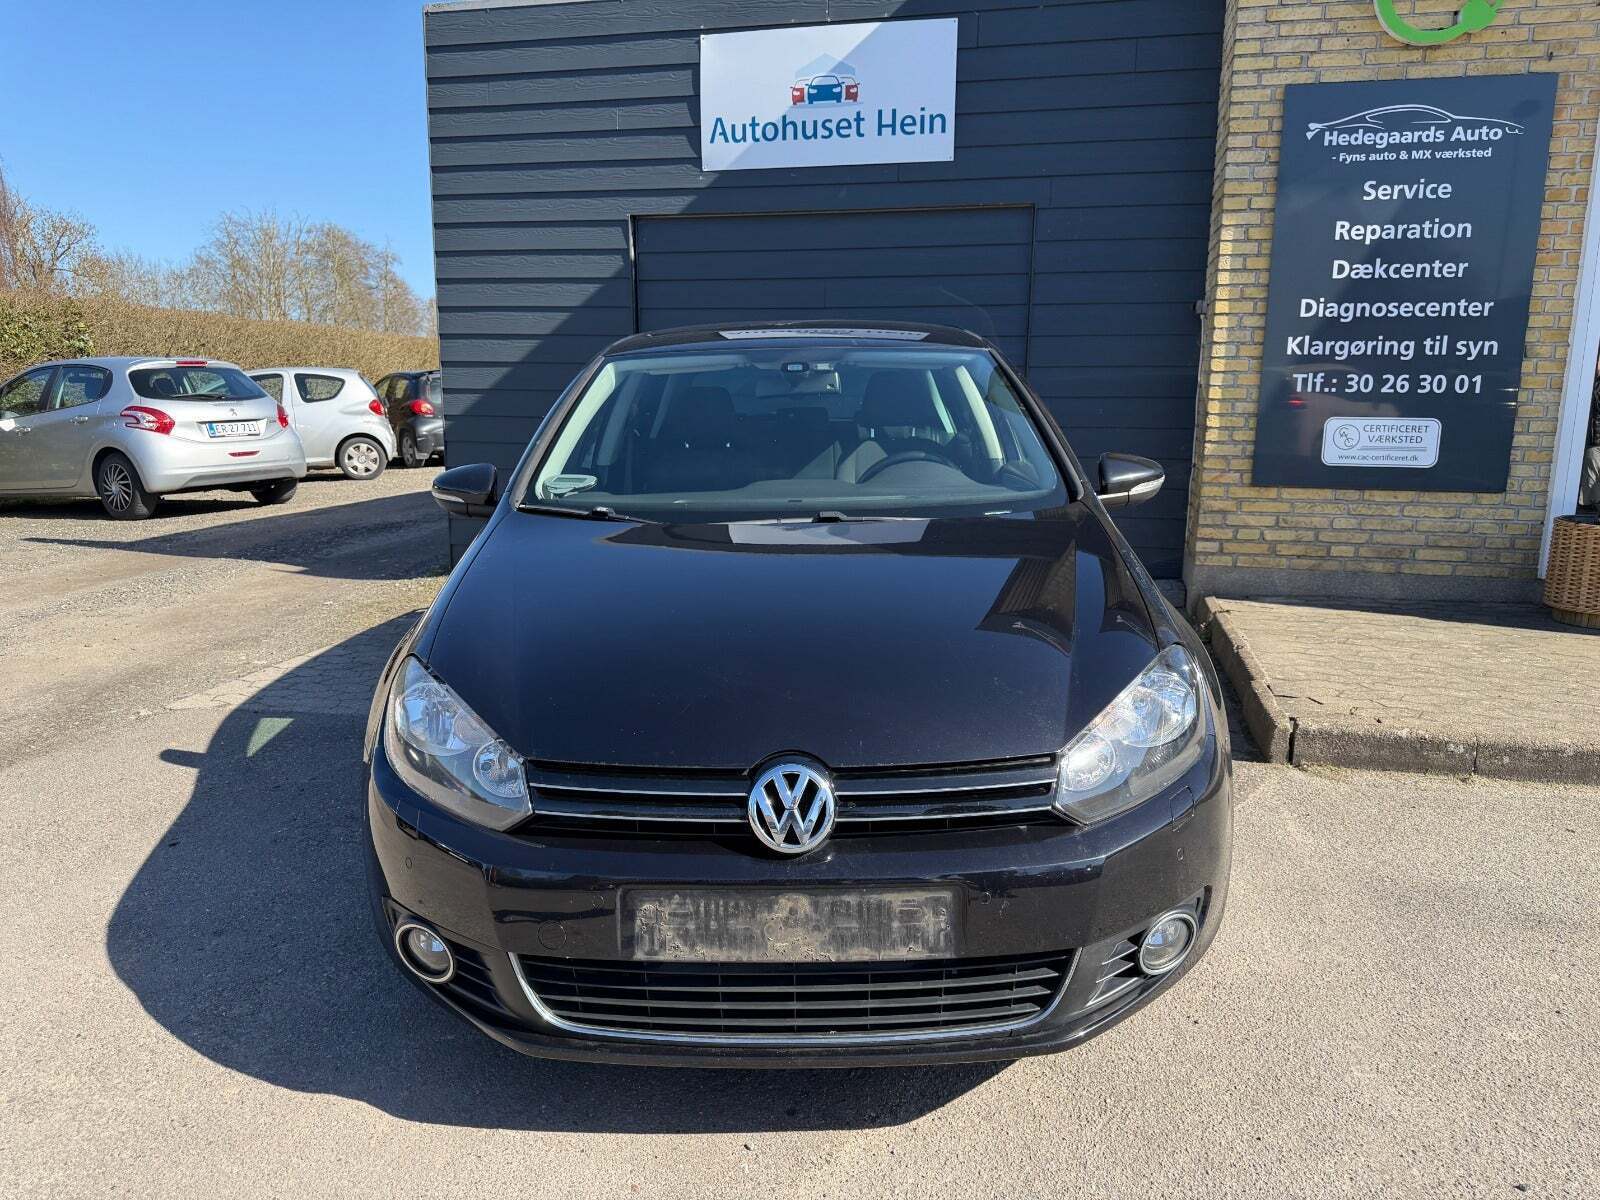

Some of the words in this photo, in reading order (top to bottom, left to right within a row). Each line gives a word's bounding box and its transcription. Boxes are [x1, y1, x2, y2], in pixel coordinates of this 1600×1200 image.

[709, 111, 865, 144] Autohuset
[877, 107, 947, 137] Hein
[1323, 126, 1445, 149] Hedegaards
[1449, 125, 1503, 142] Auto
[1339, 152, 1366, 164] Fyns
[1368, 151, 1397, 161] auto
[1399, 150, 1409, 160] &
[1411, 149, 1432, 160] MX
[1434, 147, 1492, 159] værksted
[1362, 178, 1452, 201] Service
[1334, 217, 1472, 245] Reparation
[1331, 257, 1469, 280] Dækcenter
[1299, 297, 1495, 323] Diagnosecenter
[1286, 335, 1415, 361] Klargøring
[1423, 335, 1448, 356] til
[1455, 340, 1499, 361] syn
[1292, 372, 1338, 393] Tlf.:
[1344, 373, 1374, 393] 30
[1380, 373, 1410, 394] 26
[1417, 374, 1447, 394] 30
[1454, 374, 1483, 394] 01
[230, 423, 239, 433] 27
[241, 423, 257, 432] 711
[1363, 424, 1430, 433] CERTIFICERET
[1367, 435, 1423, 444] VÆRKSTED
[1337, 453, 1419, 462] www.cac-certificeret.dk
